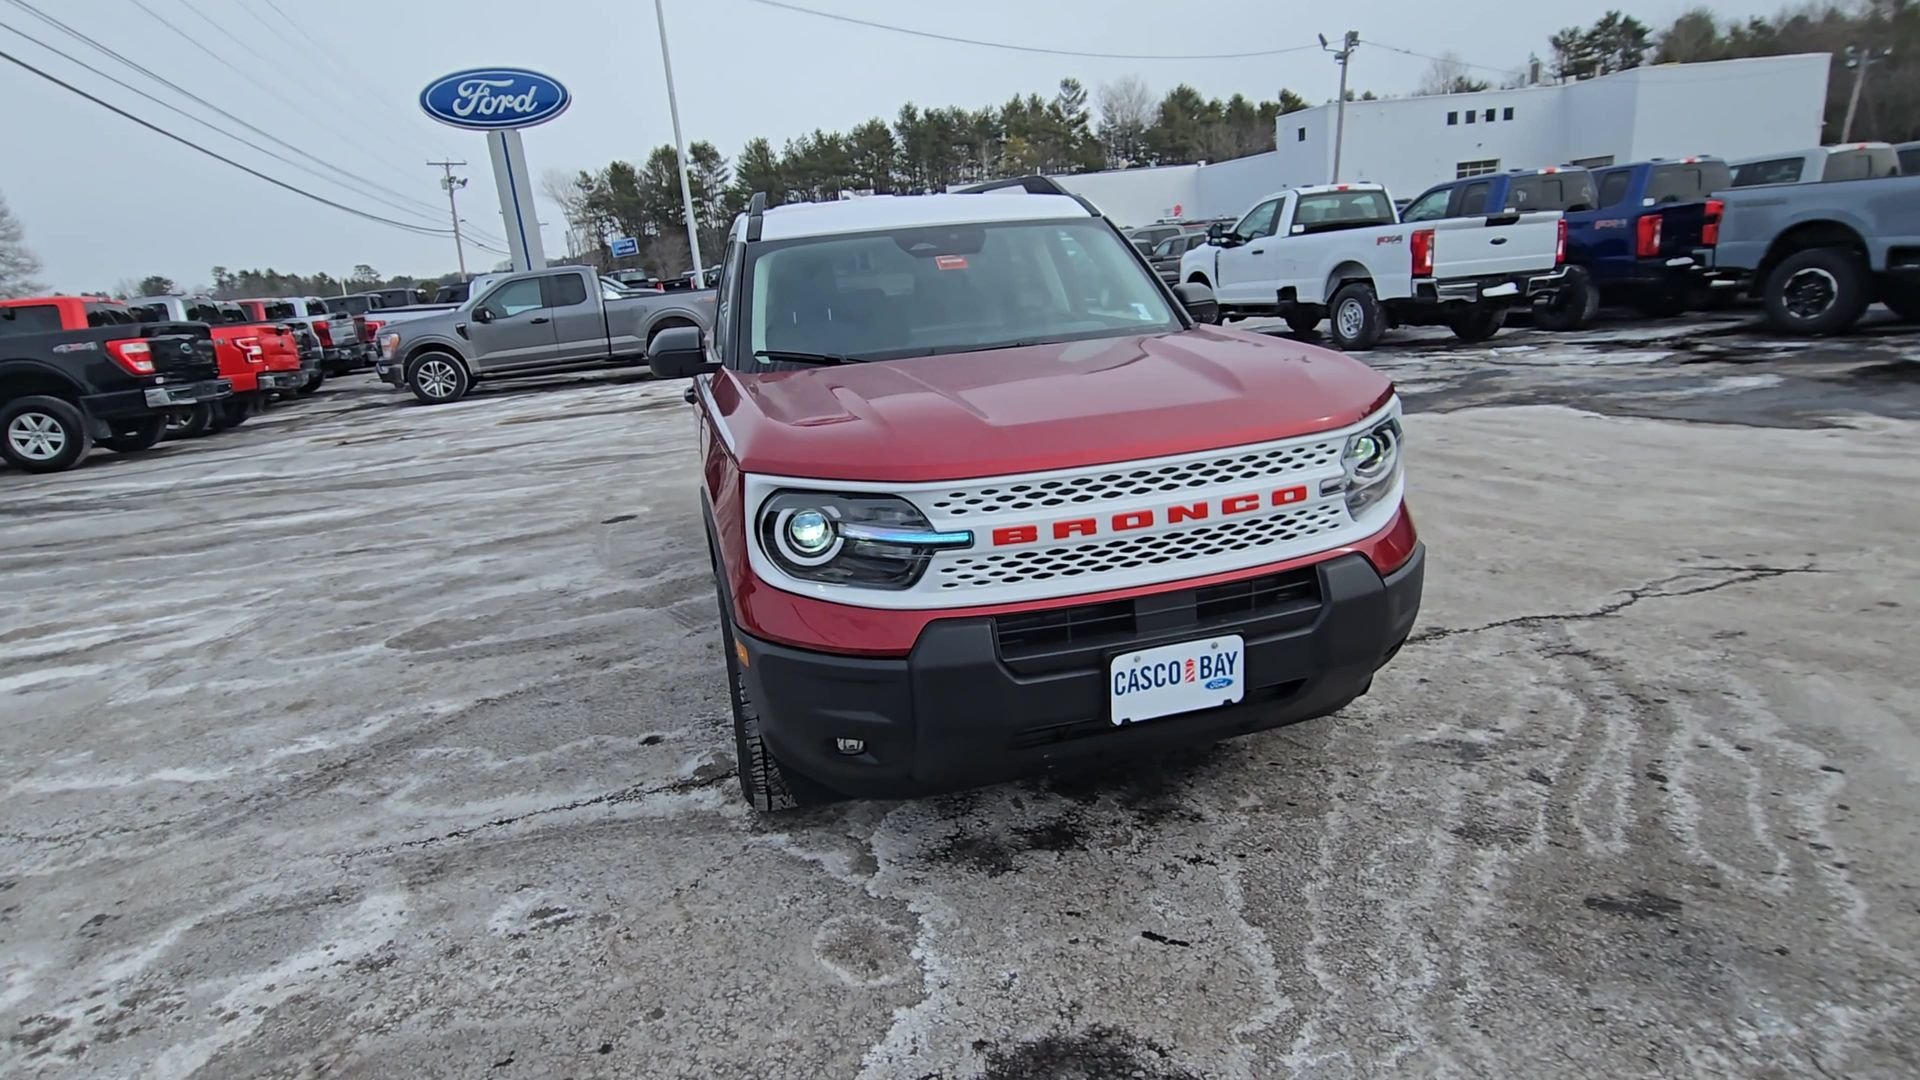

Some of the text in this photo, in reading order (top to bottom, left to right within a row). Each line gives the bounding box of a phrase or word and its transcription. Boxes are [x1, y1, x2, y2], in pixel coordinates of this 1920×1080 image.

[452, 79, 538, 116] Ford
[992, 485, 1307, 546] BRONCO
[1114, 651, 1238, 696] CASCO BAY
